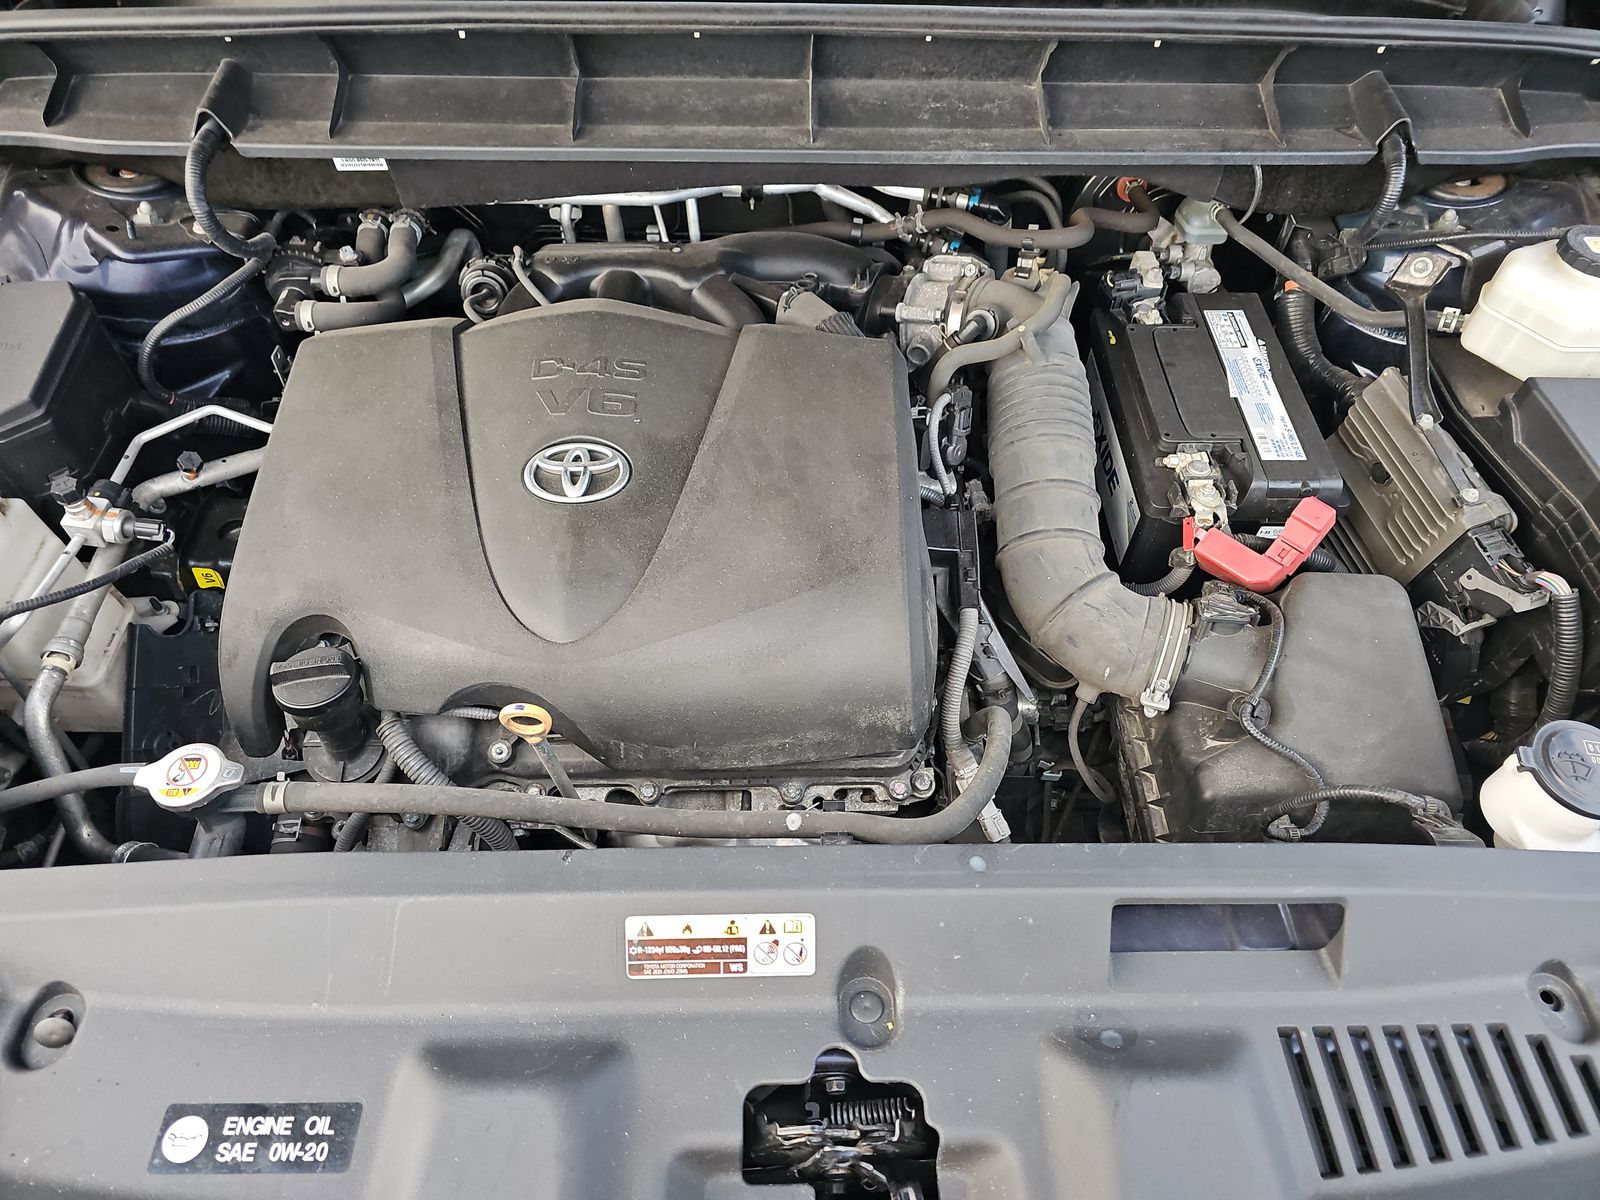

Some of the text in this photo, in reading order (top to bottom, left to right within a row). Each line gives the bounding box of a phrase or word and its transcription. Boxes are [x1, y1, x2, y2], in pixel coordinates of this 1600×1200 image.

[530, 356, 648, 381] D-4S
[1252, 356, 1269, 380] EXIDE
[535, 387, 638, 417] V6
[1093, 410, 1120, 497] EXIDE
[201, 572, 216, 583] V6
[729, 963, 744, 973] WS
[222, 1115, 335, 1136] ENGINE OIL
[215, 1142, 329, 1162] SAE 0W-20
